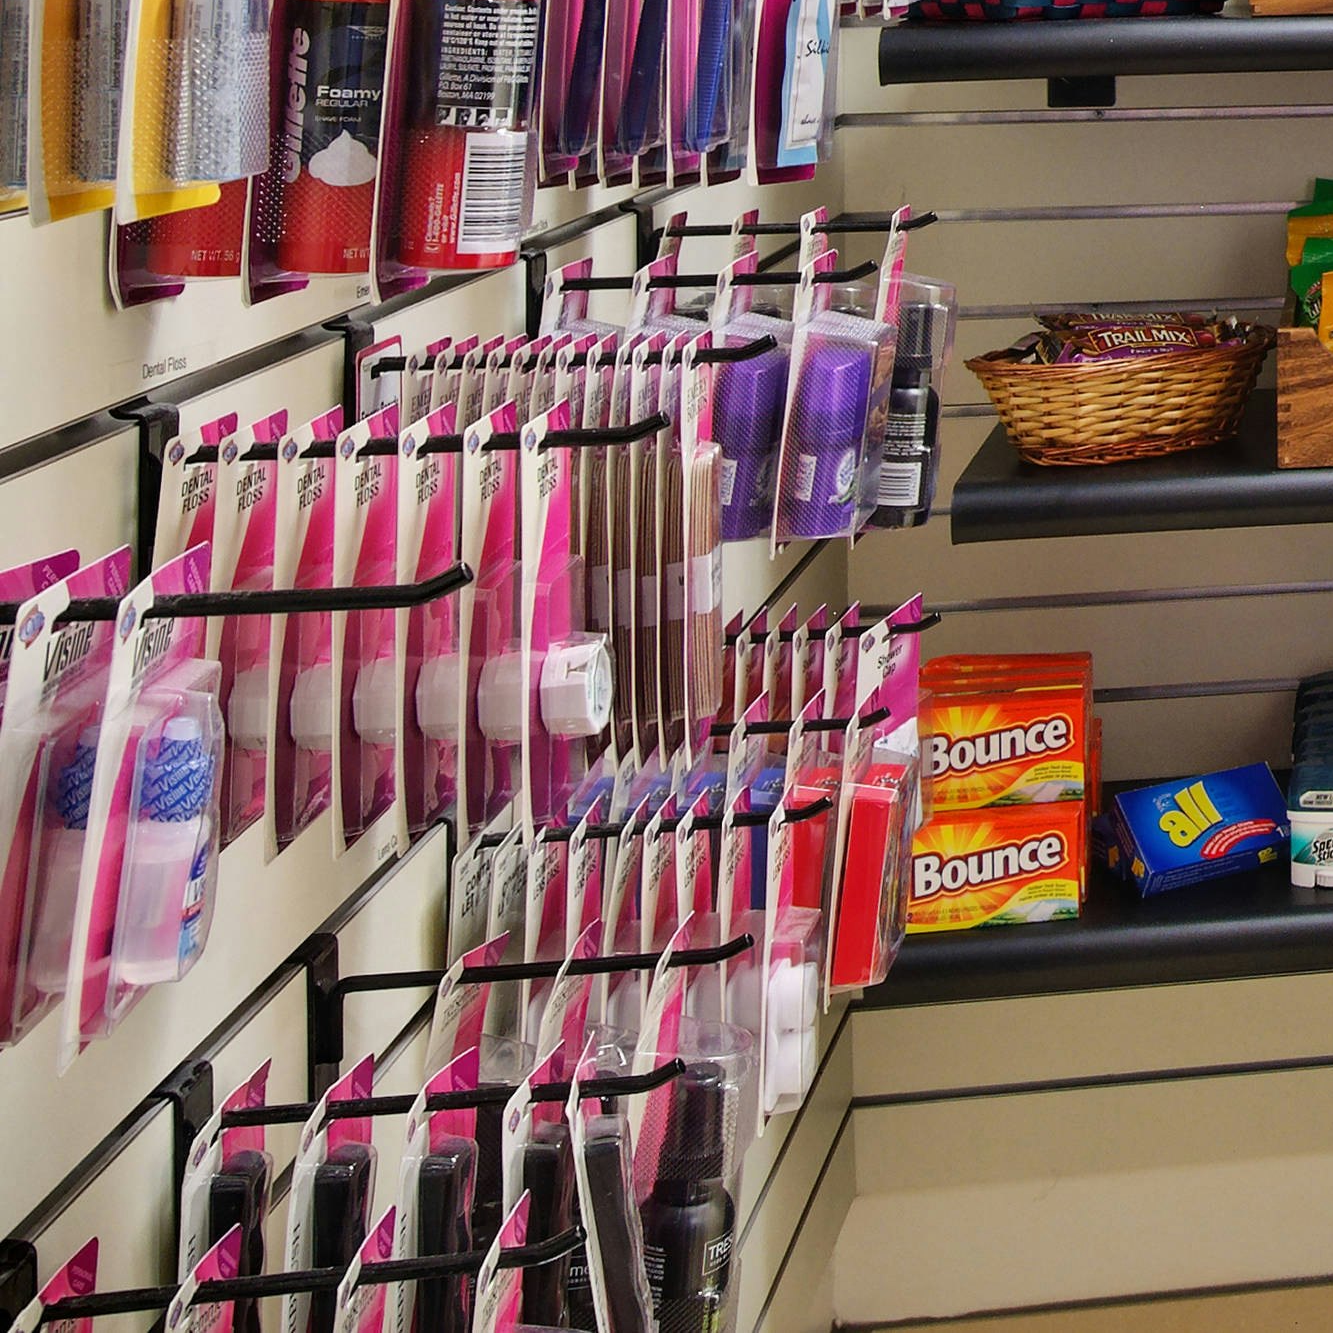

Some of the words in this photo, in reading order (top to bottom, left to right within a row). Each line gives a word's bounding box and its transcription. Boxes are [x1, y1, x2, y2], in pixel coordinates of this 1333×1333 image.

[316, 99, 368, 107] REGULAR
[317, 85, 381, 101] Foamy
[1098, 330, 1151, 347] TRAIL
[1152, 329, 1190, 343] MIX
[142, 360, 166, 379] Dental
[167, 356, 187, 373] Floss
[182, 468, 213, 497] DENTAL
[236, 467, 266, 496] DENTAL
[297, 466, 326, 494] DENTAL
[354, 463, 382, 491] DENTAL
[416, 460, 440, 488] DENTAL
[479, 458, 503, 487] DENTAL
[537, 458, 558, 485] DENTAL
[182, 488, 210, 515] FLOSS
[237, 486, 263, 514] FLOSS
[298, 484, 322, 511] FLOSS
[356, 480, 380, 506] FLOSS
[417, 479, 438, 505] FLOSS
[480, 477, 500, 503] FLOSS
[538, 476, 558, 500] FLOSS
[42, 621, 94, 682] Visine
[132, 617, 174, 678] Visine
[877, 644, 904, 669] Shower
[921, 719, 1067, 778] Bounce
[1159, 780, 1223, 848] all
[914, 836, 1062, 898] Bounce
